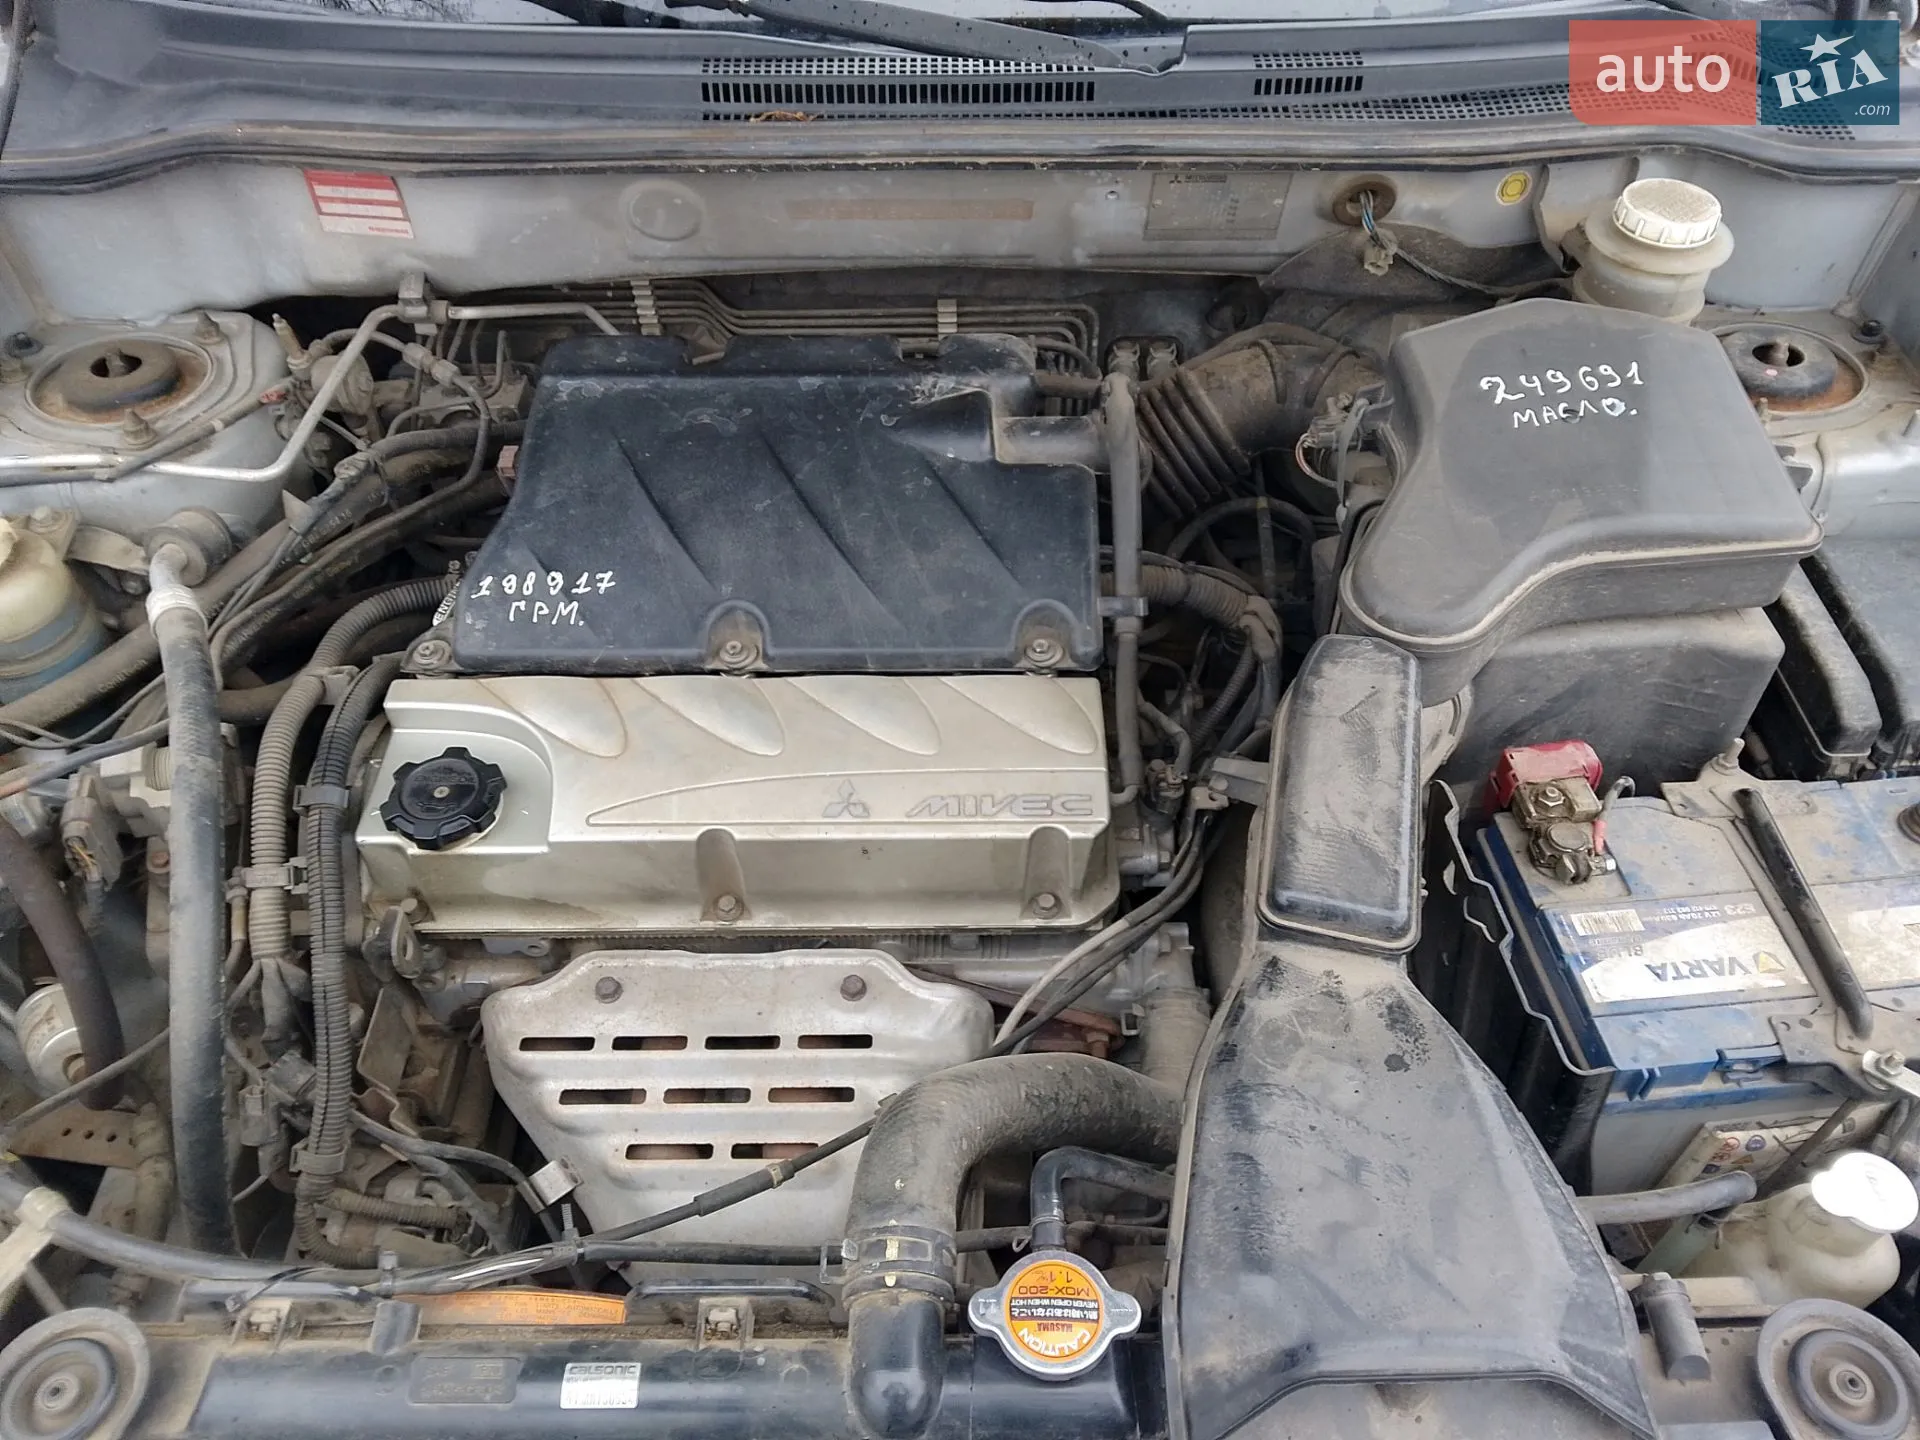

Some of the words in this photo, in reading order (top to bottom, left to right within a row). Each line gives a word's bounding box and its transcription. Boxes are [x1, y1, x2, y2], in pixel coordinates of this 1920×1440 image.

[1479, 361, 1644, 404] 249691
[905, 793, 1094, 818] MIVEC
[1643, 956, 1753, 983] VARTA
[1018, 1285, 1090, 1297] MOX-200
[1010, 1298, 1027, 1306] HOT
[1027, 1298, 1050, 1307] WHEN
[1050, 1299, 1073, 1307] OPEN
[1072, 1300, 1098, 1309] NEVER
[1037, 1322, 1073, 1333] MASUMA
[1018, 1327, 1091, 1356] CAUTION
